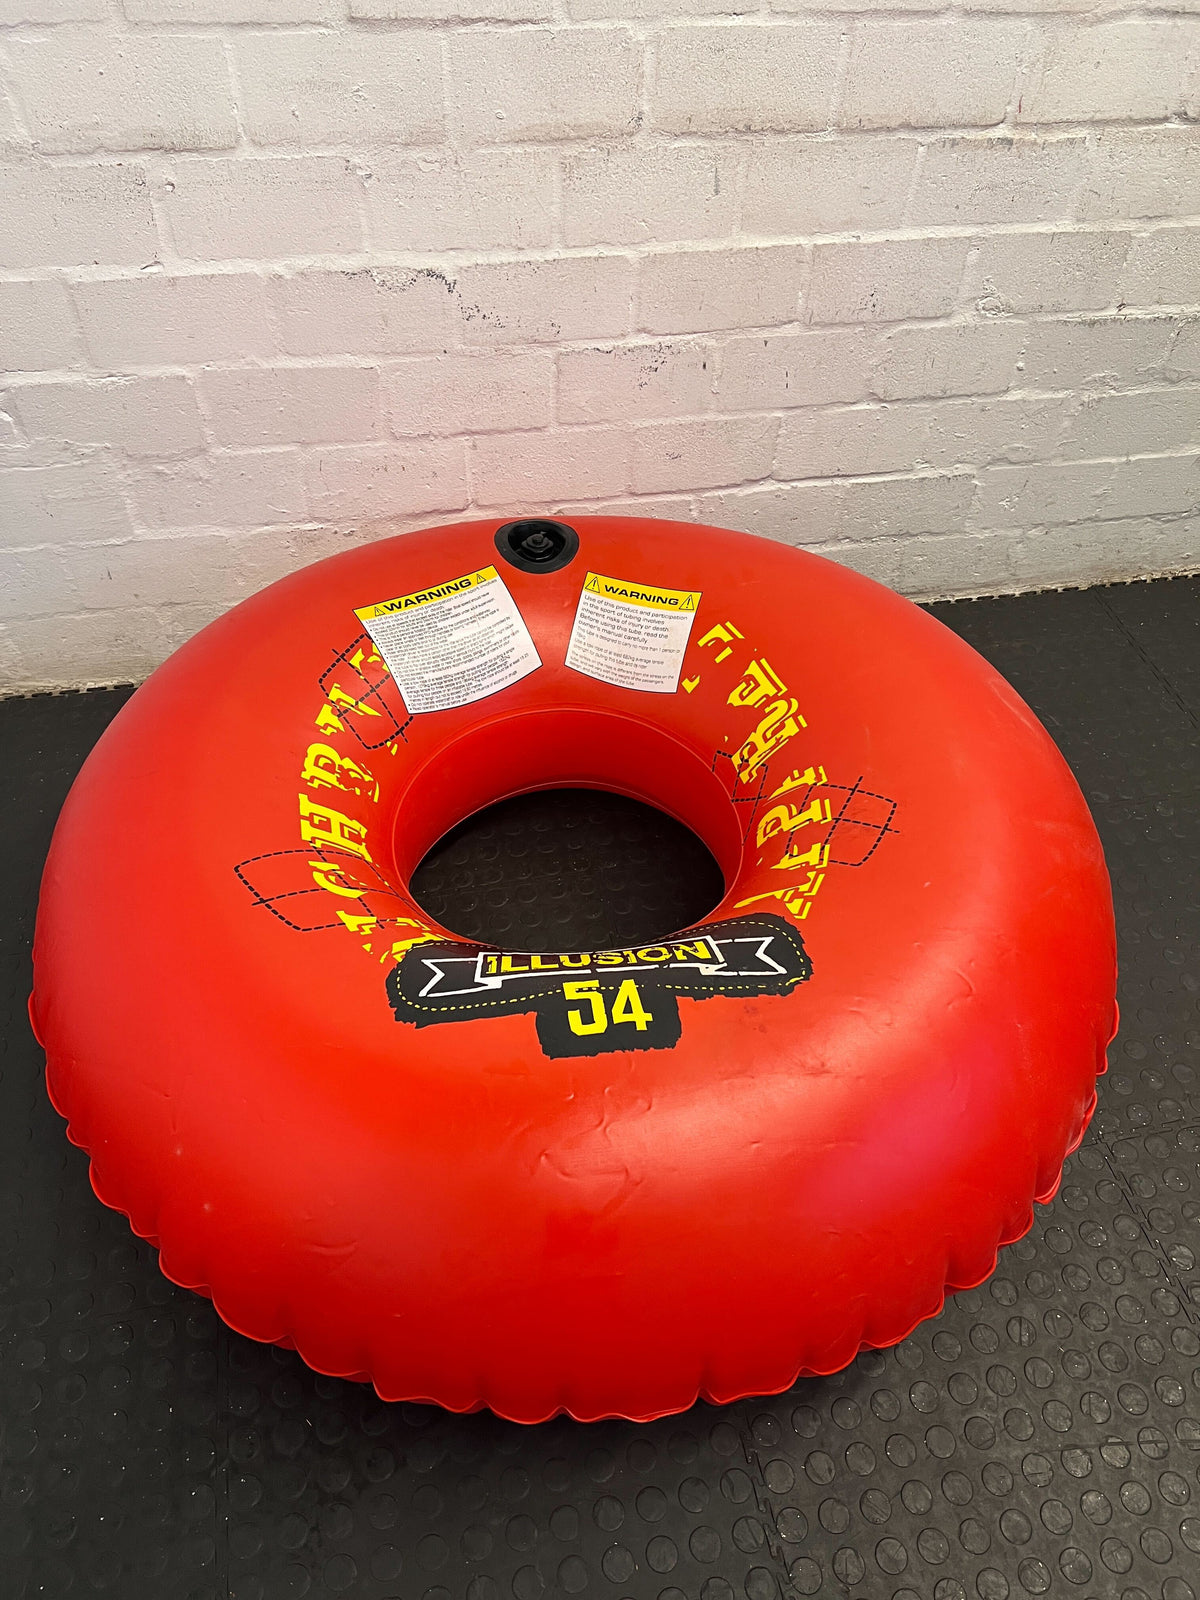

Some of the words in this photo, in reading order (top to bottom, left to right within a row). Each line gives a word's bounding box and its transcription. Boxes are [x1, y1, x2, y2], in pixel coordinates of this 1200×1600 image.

[383, 579, 471, 611] WARNING
[605, 585, 679, 605] WARNING
[584, 594, 596, 602] Use
[616, 606, 638, 614] product
[652, 612, 688, 620] participation
[600, 607, 616, 616] sport
[624, 614, 642, 622] tubing
[578, 620, 600, 632] owner's
[602, 628, 623, 638] manual
[580, 612, 600, 624] Before
[600, 622, 616, 630] using
[581, 608, 606, 619] inherent
[606, 616, 620, 624] risks
[628, 621, 644, 630] injury
[486, 941, 711, 974] ILLUSION
[563, 979, 653, 1036] 54
